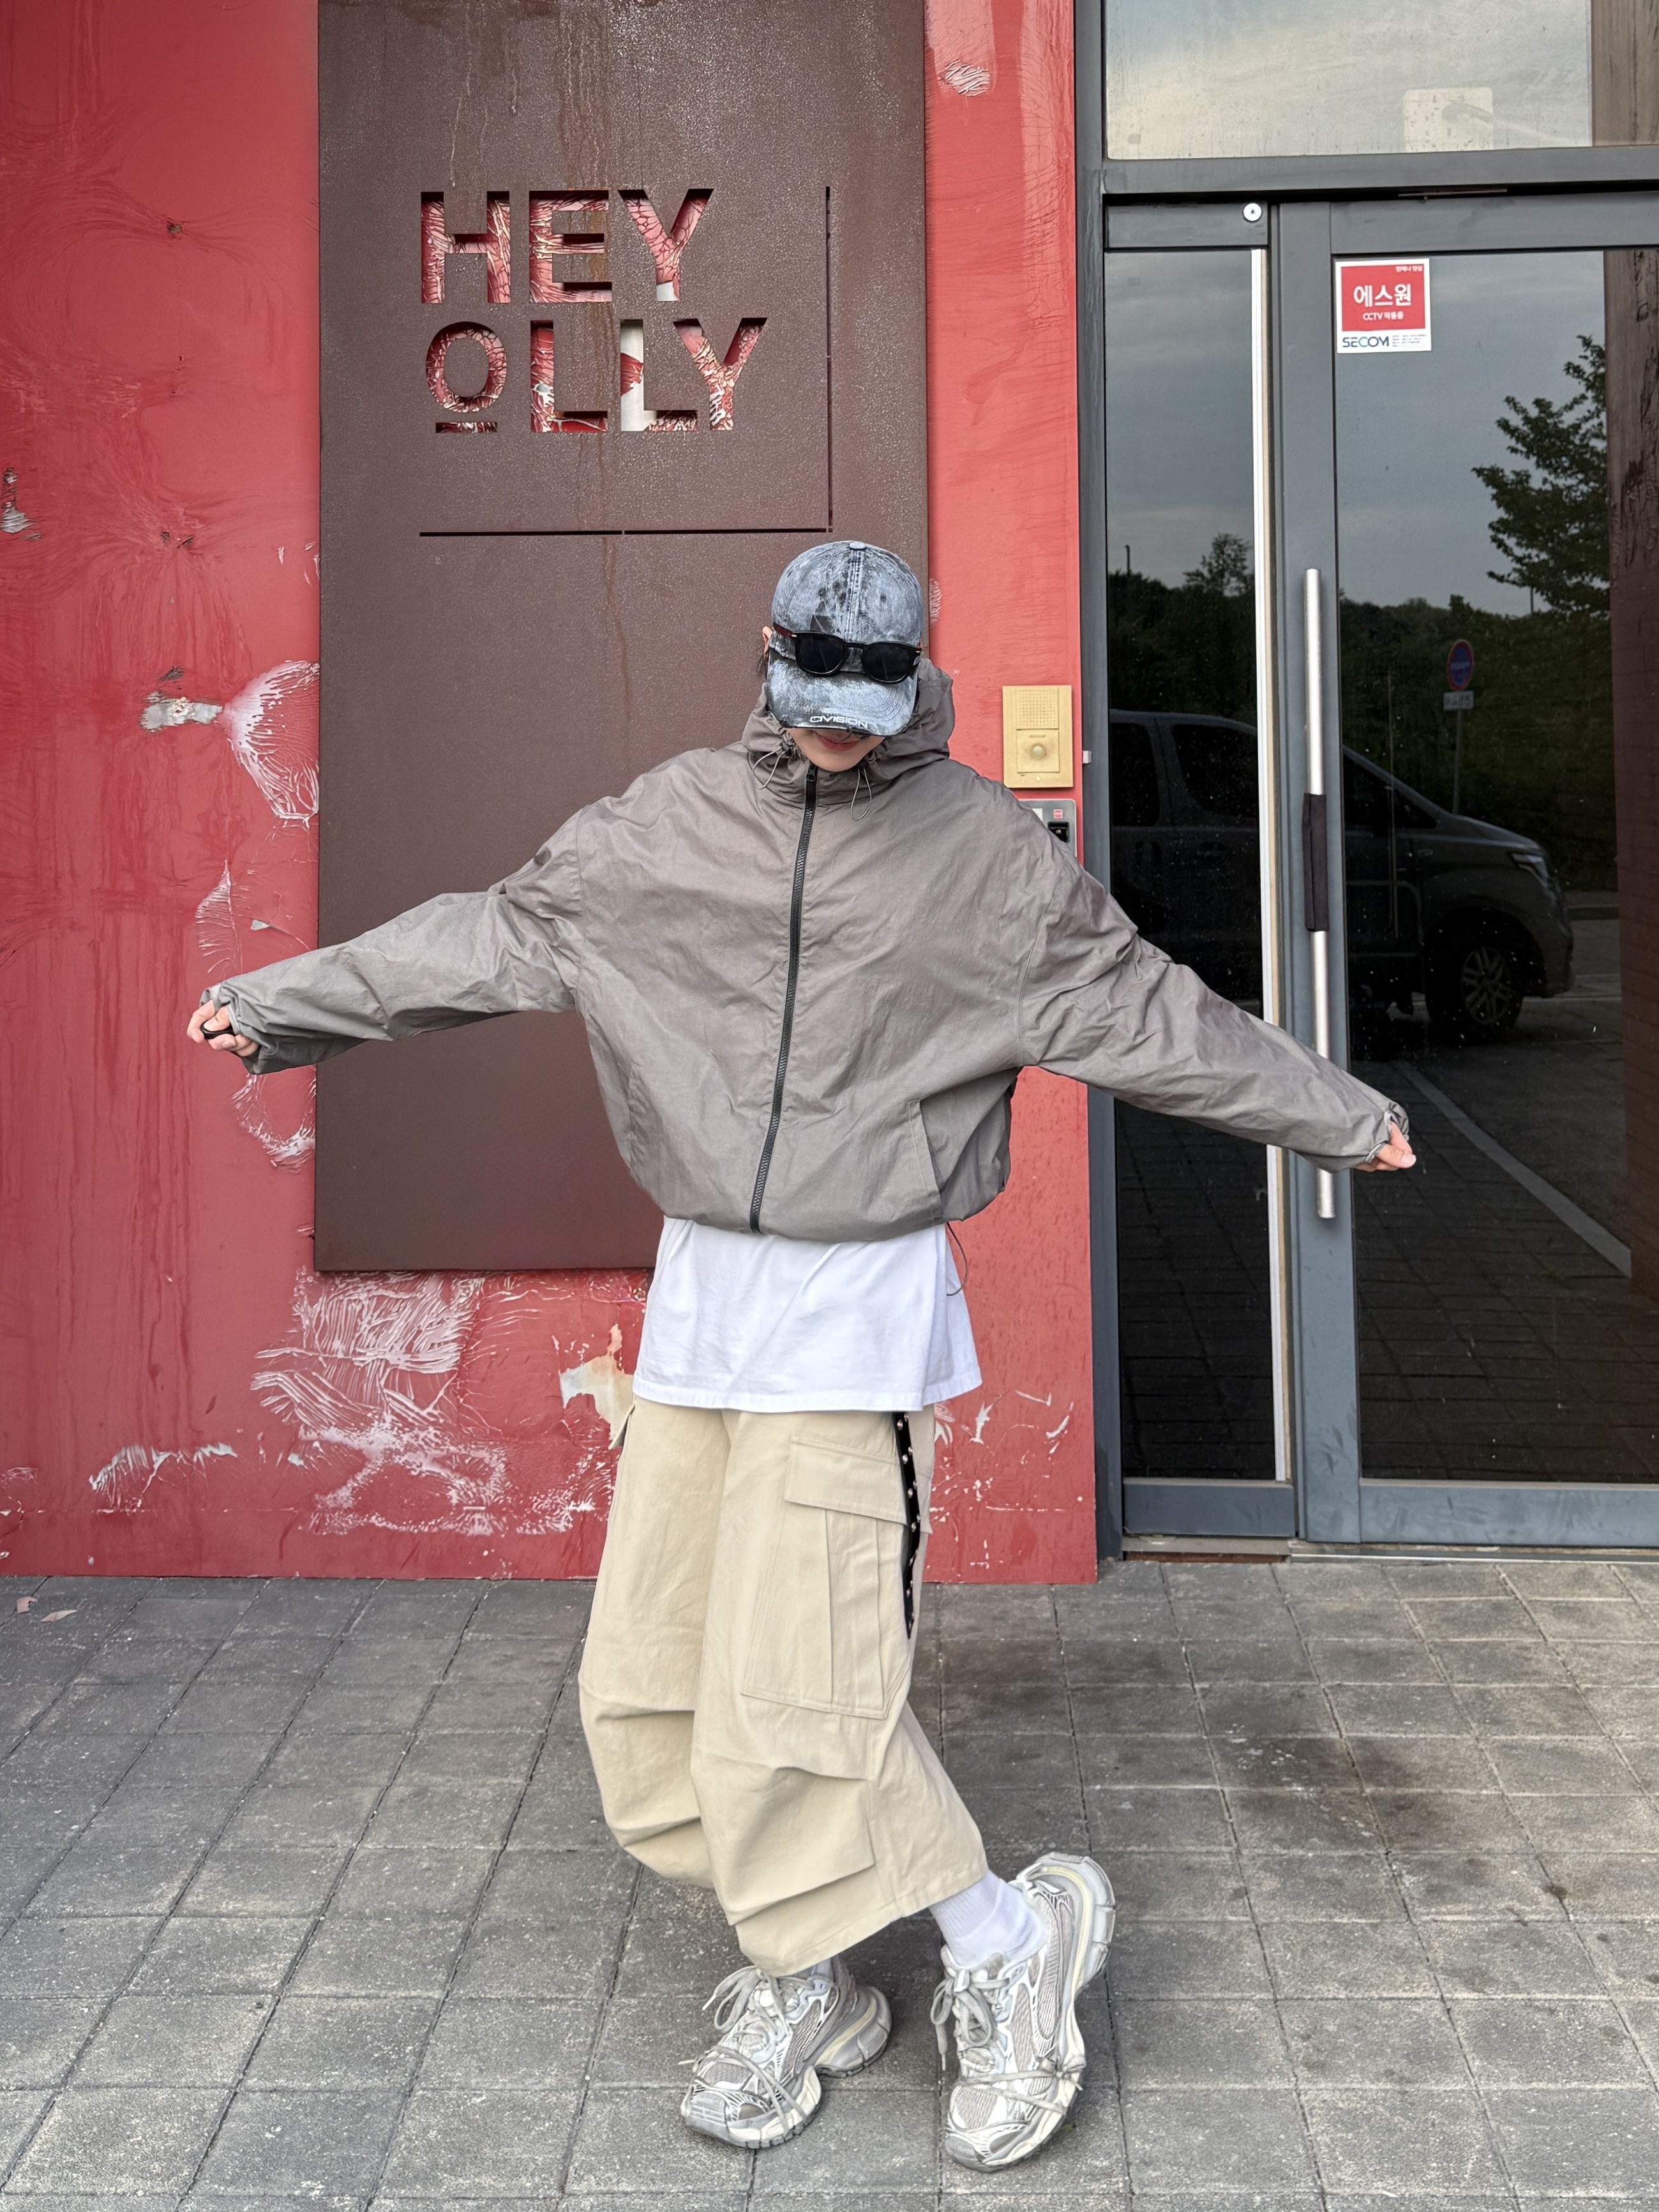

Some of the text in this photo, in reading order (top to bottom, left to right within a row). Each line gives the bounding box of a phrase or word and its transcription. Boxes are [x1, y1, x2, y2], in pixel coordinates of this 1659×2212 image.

[421, 188, 714, 304] HEY
[1353, 283, 1411, 308] 에스원
[1362, 312, 1383, 321] CCTV
[1342, 336, 1389, 348] SECOM
[425, 317, 767, 433] OLLY
